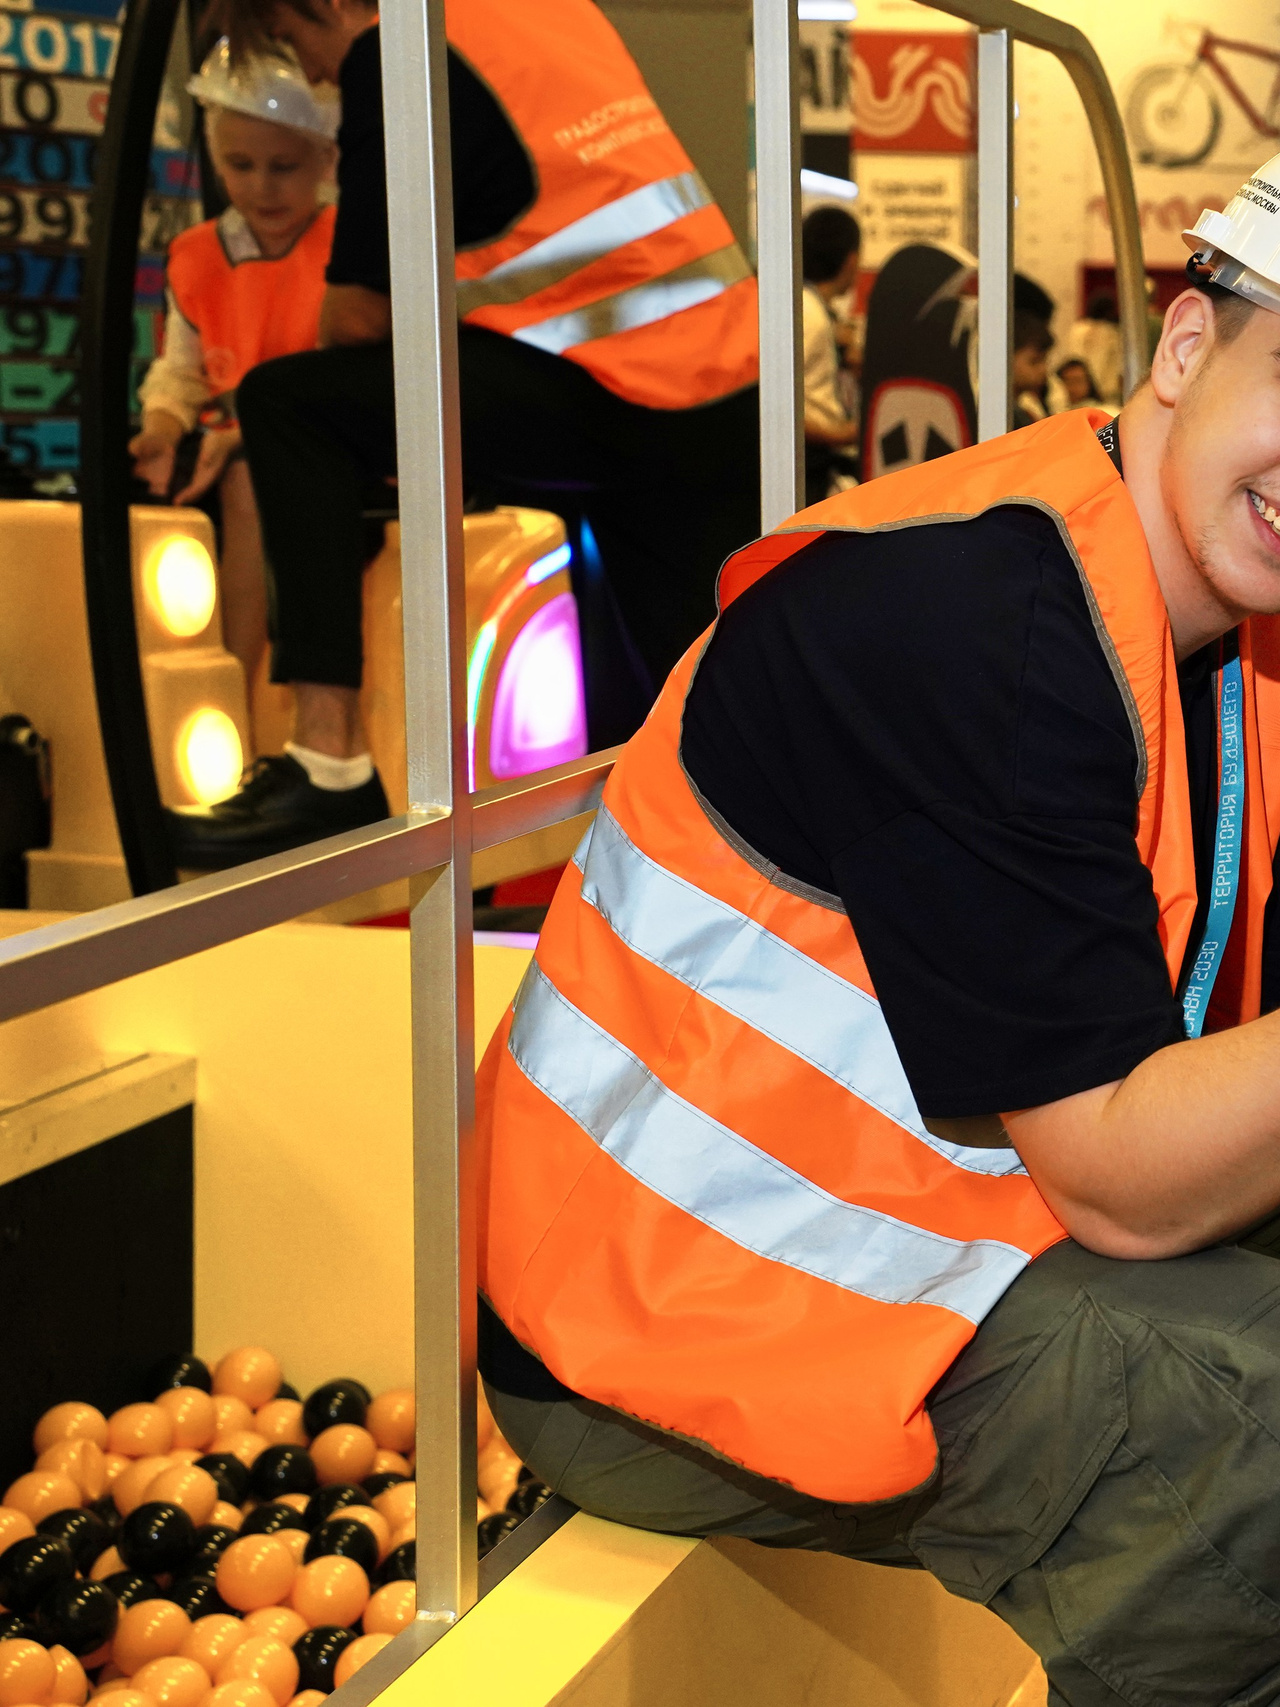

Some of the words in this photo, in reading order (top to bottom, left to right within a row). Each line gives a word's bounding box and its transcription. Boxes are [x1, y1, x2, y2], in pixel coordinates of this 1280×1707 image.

[1252, 193, 1280, 215] МОСКВЫ
[1223, 681, 1238, 786] БУДУЩЕГО
[1213, 793, 1237, 909] ТЕРРИТОРИЯ
[1191, 941, 1219, 981] 2030
